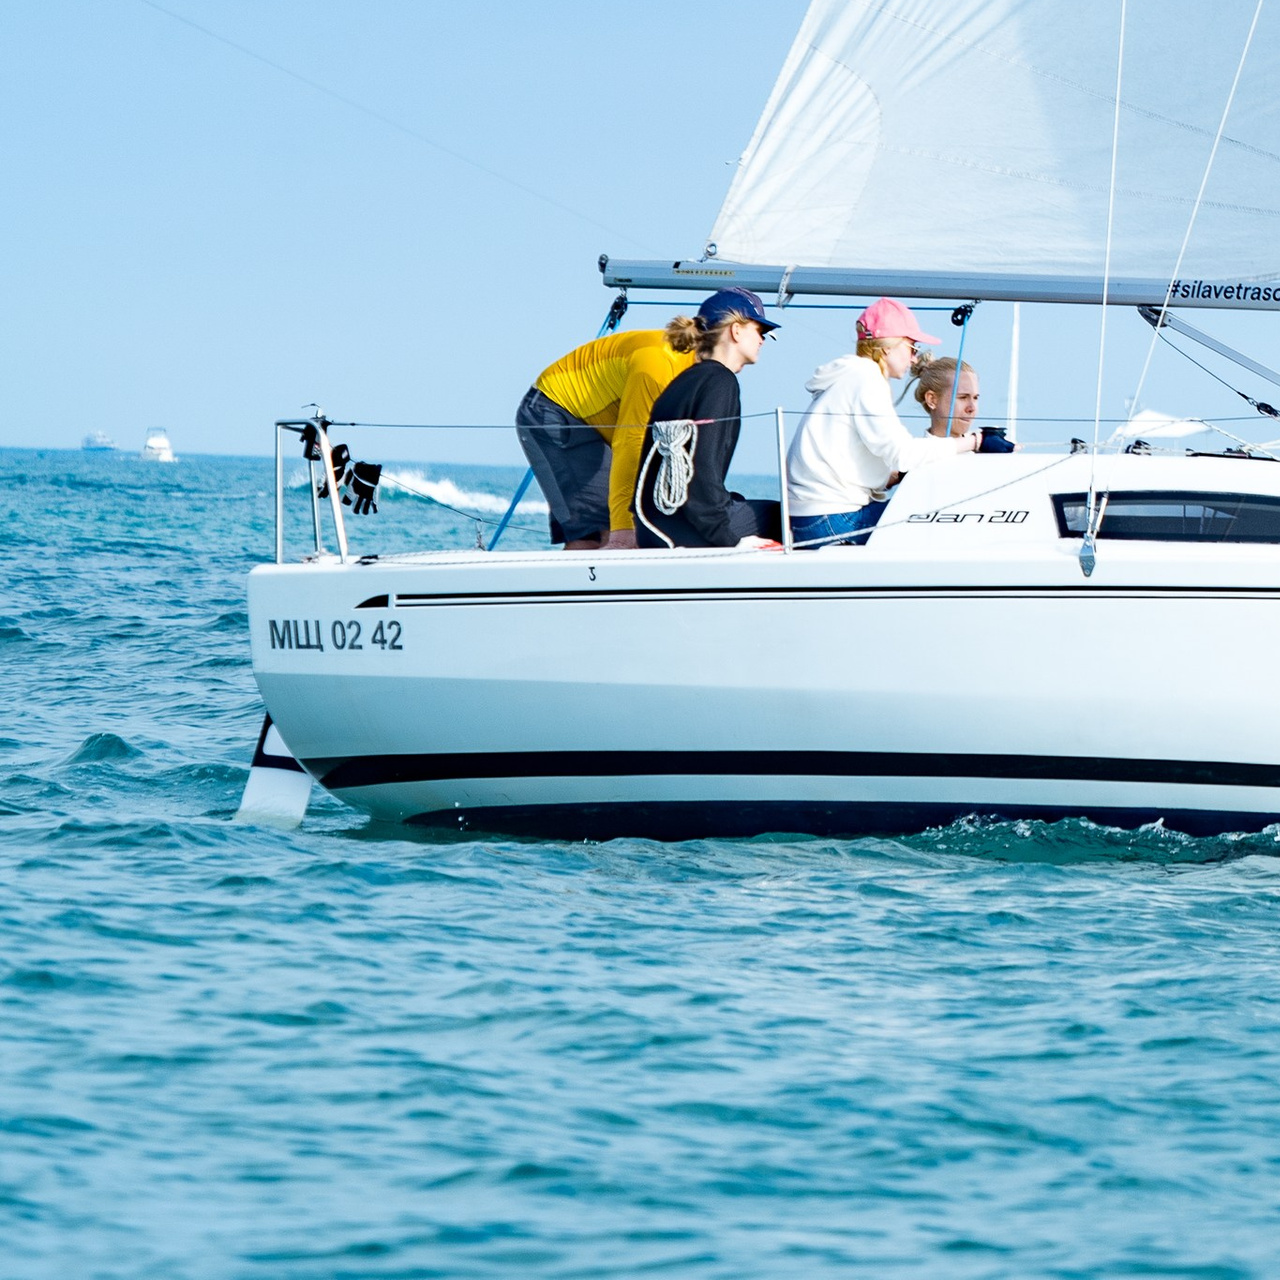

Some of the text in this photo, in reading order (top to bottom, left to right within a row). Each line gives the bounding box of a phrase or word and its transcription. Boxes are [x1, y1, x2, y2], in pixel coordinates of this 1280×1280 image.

[907, 510, 1030, 523] elan 210
[268, 619, 403, 652] МЩ 02 42
